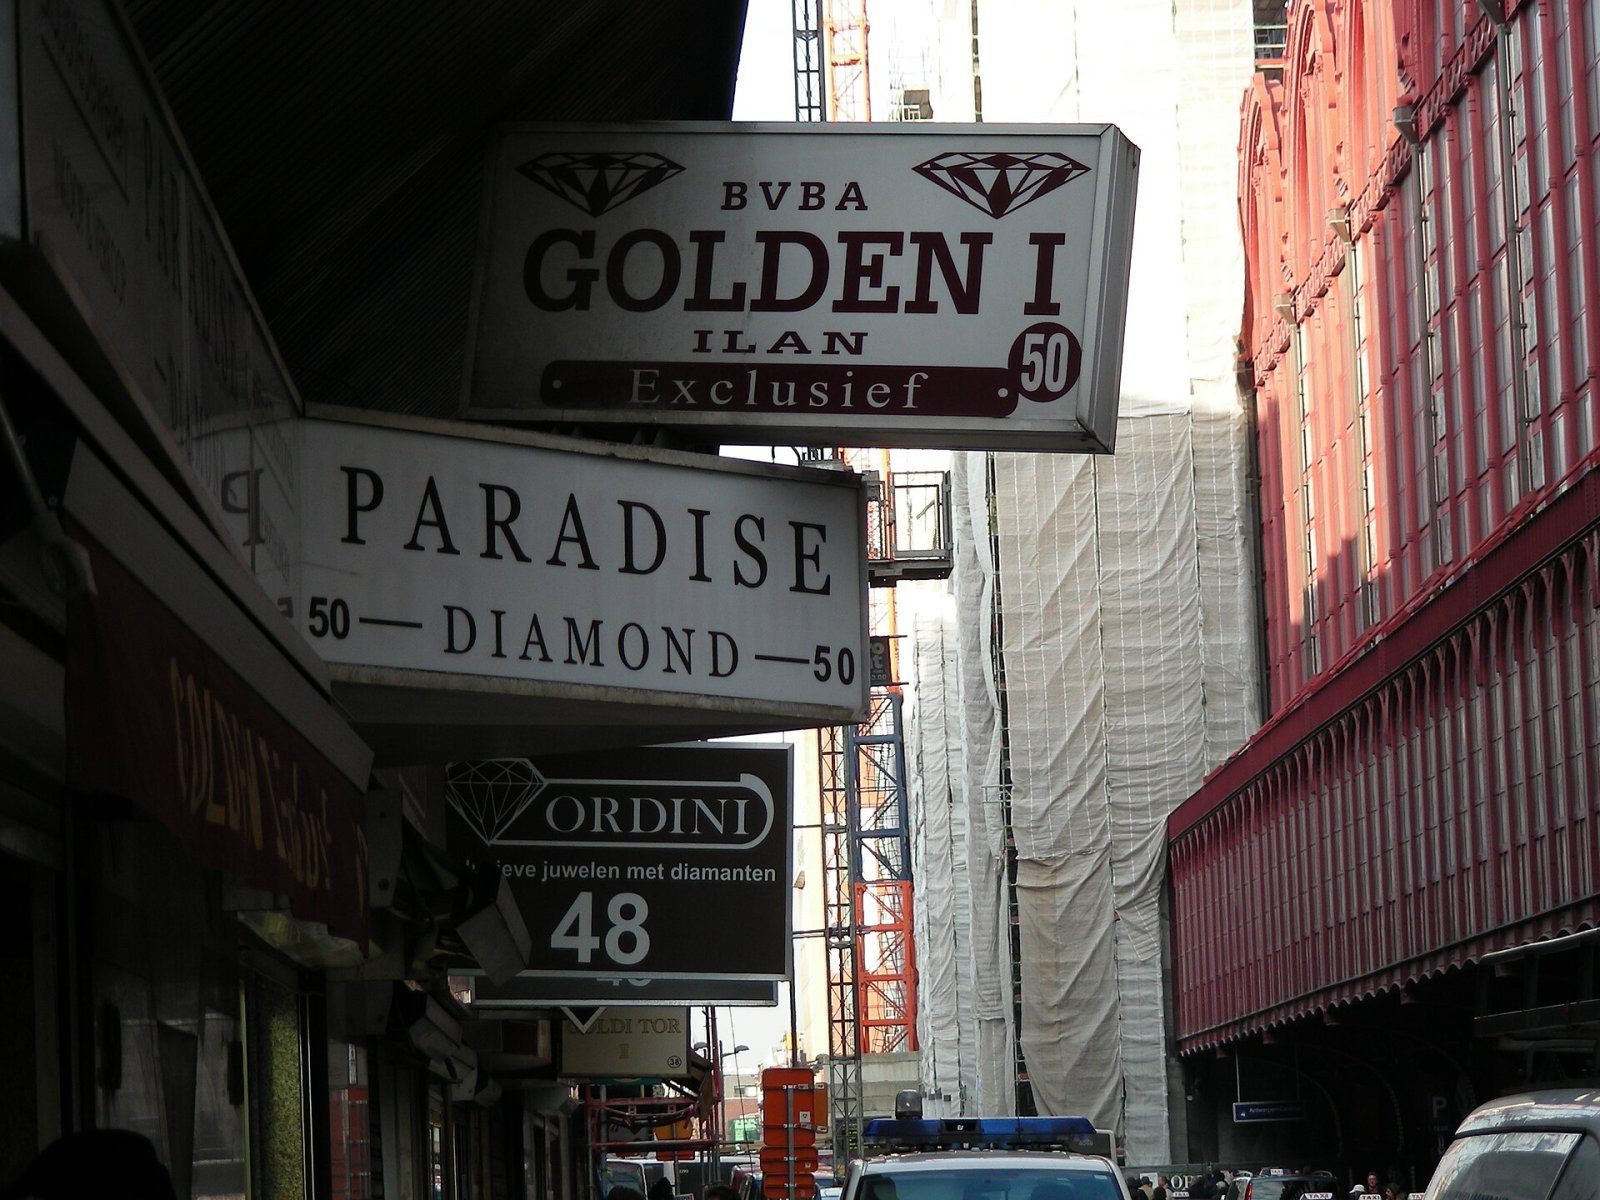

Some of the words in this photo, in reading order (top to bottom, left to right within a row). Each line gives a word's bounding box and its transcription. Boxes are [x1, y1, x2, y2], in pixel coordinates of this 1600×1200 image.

[721, 181, 869, 212] BVBA
[522, 228, 993, 315] GOLDEN
[1023, 232, 1066, 316] I
[692, 330, 869, 356] ILAN
[1020, 332, 1062, 393] 50
[629, 367, 930, 409] Exclusief
[340, 465, 831, 595] PARADISE
[308, 597, 350, 640] 50
[442, 605, 740, 679] DIAMOND
[812, 646, 855, 685] 50
[545, 795, 750, 836] ORDINI
[541, 860, 620, 882] juwelen
[627, 863, 665, 881] met
[670, 862, 776, 882] diamanten
[551, 891, 650, 965] 48
[638, 1018, 681, 1034] TOR
